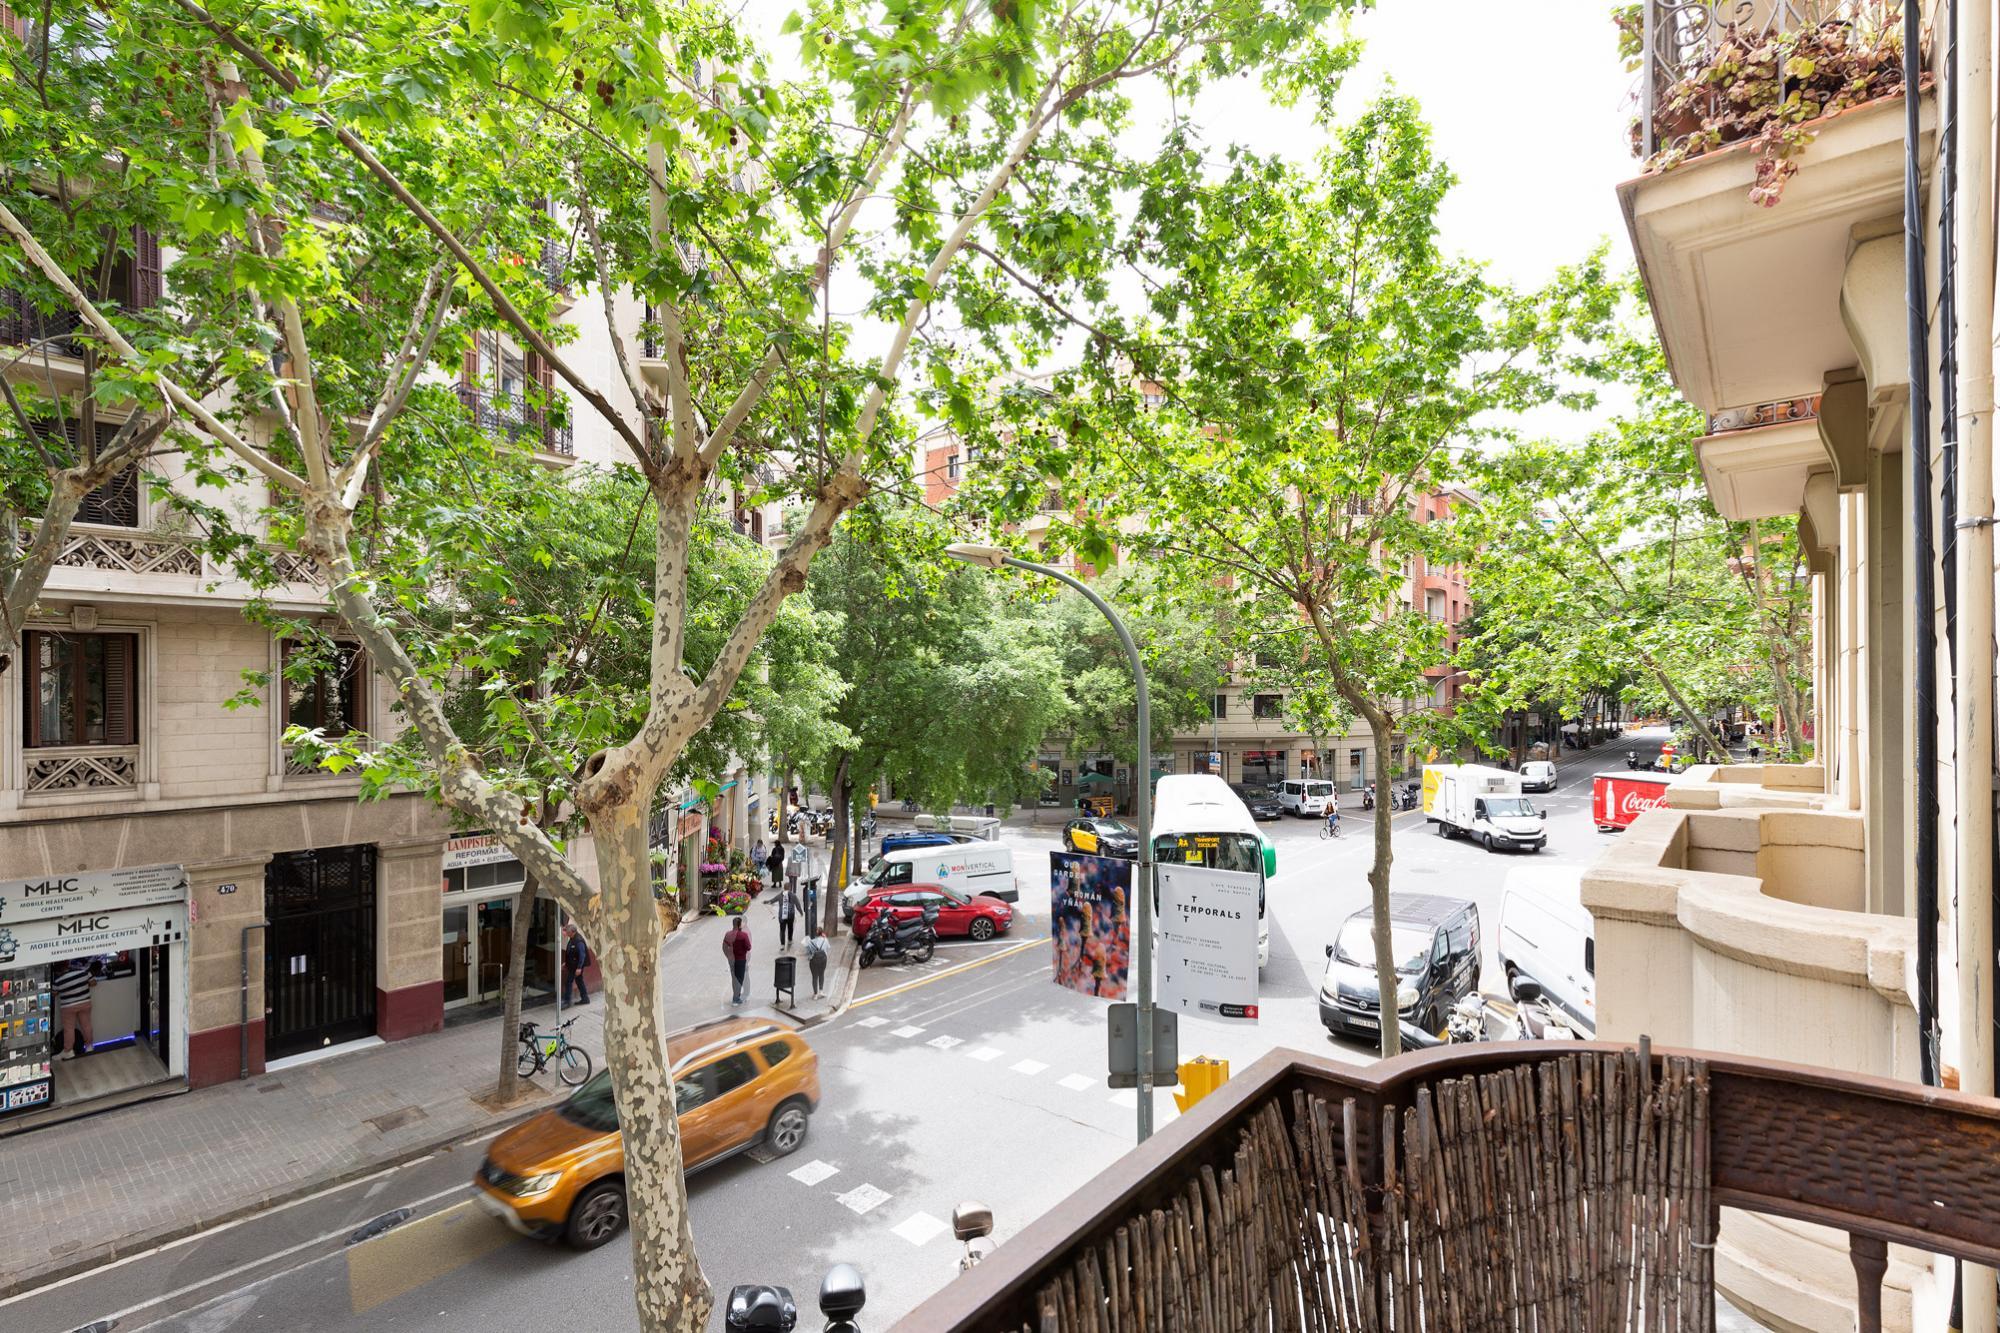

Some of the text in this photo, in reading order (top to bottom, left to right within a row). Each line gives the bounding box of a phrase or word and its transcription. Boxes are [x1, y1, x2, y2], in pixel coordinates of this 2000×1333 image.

[1622, 791, 1668, 814] Coca-C
[455, 847, 498, 859] REFORMAS
[25, 878, 79, 897] MHC
[220, 885, 235, 893] 470
[20, 896, 84, 908] MOBILE HEALTHCARE
[1177, 903, 1241, 920] TEMPORALS
[58, 916, 109, 936] MHC
[30, 929, 138, 951] MOBILE HEALTHCARE CENTRE
